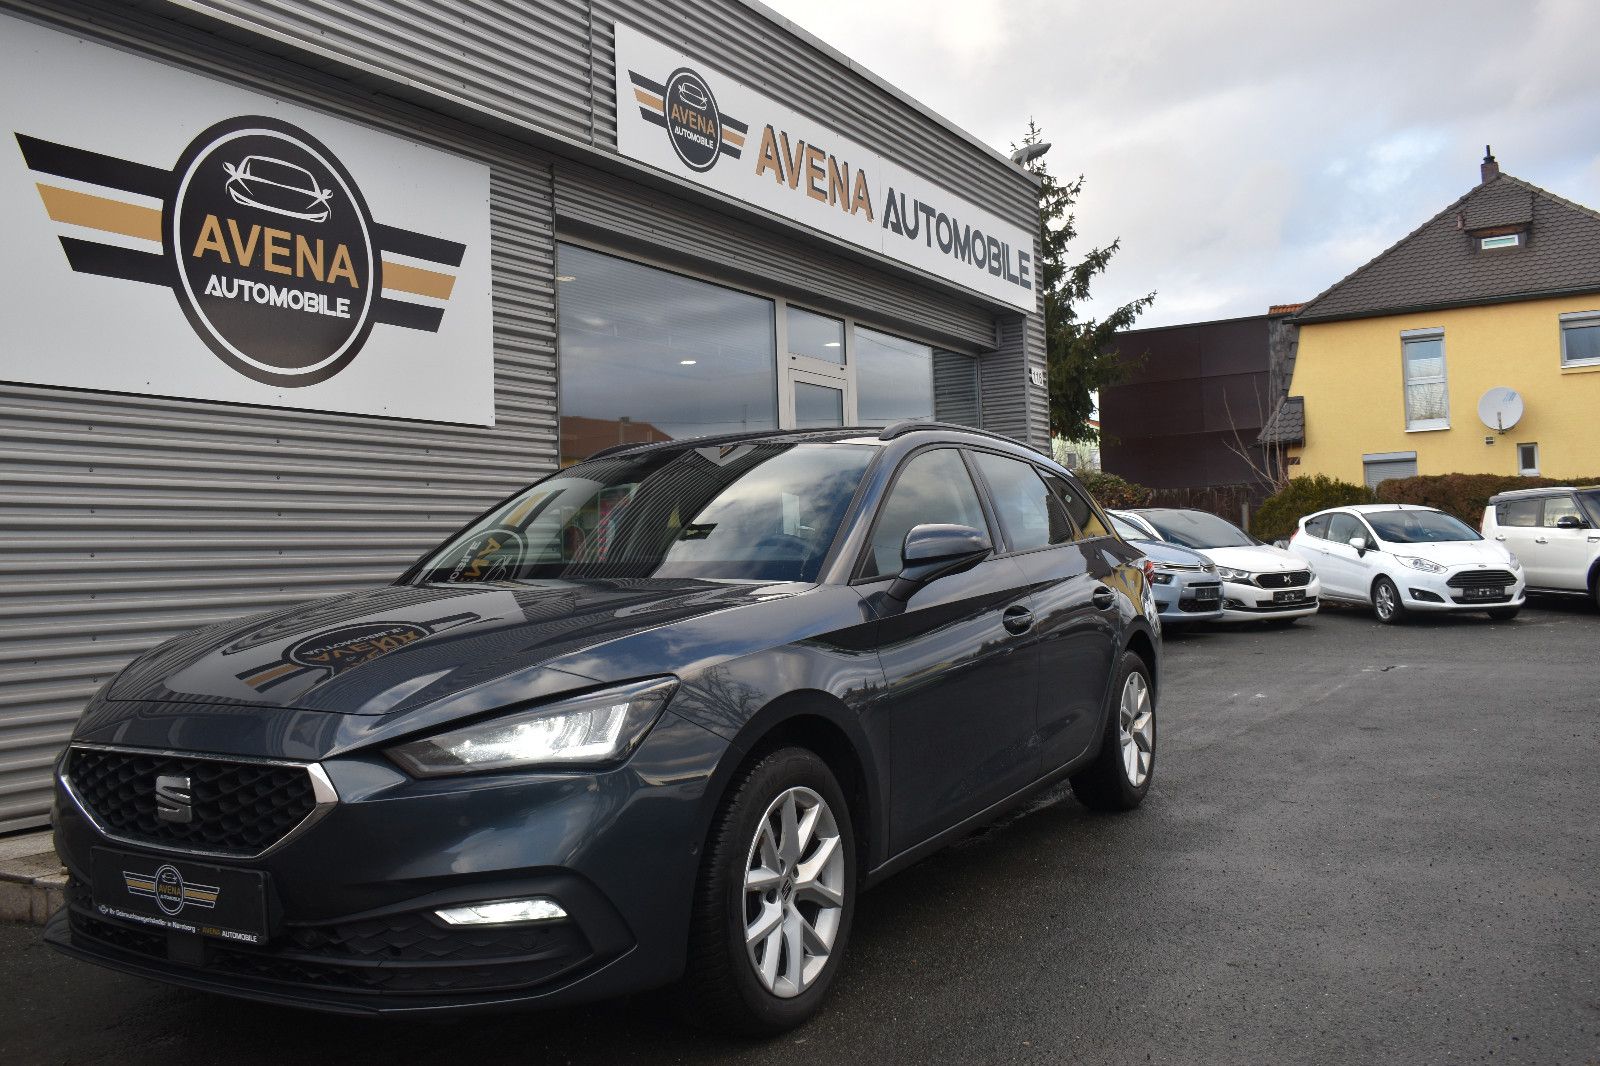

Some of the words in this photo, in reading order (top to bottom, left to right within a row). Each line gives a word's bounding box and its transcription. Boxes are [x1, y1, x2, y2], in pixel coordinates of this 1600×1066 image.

[670, 103, 716, 138] AVENA
[674, 125, 714, 149] AUTOMOBILE
[755, 123, 875, 223] AVENA
[882, 187, 1032, 290] AUTOMOBILE
[192, 213, 360, 289] AVENA
[204, 274, 351, 319] AUTOMOBILE
[158, 883, 181, 896] AVENA
[202, 926, 221, 936] AVENA
[221, 930, 258, 943] AUTOMOBILE
